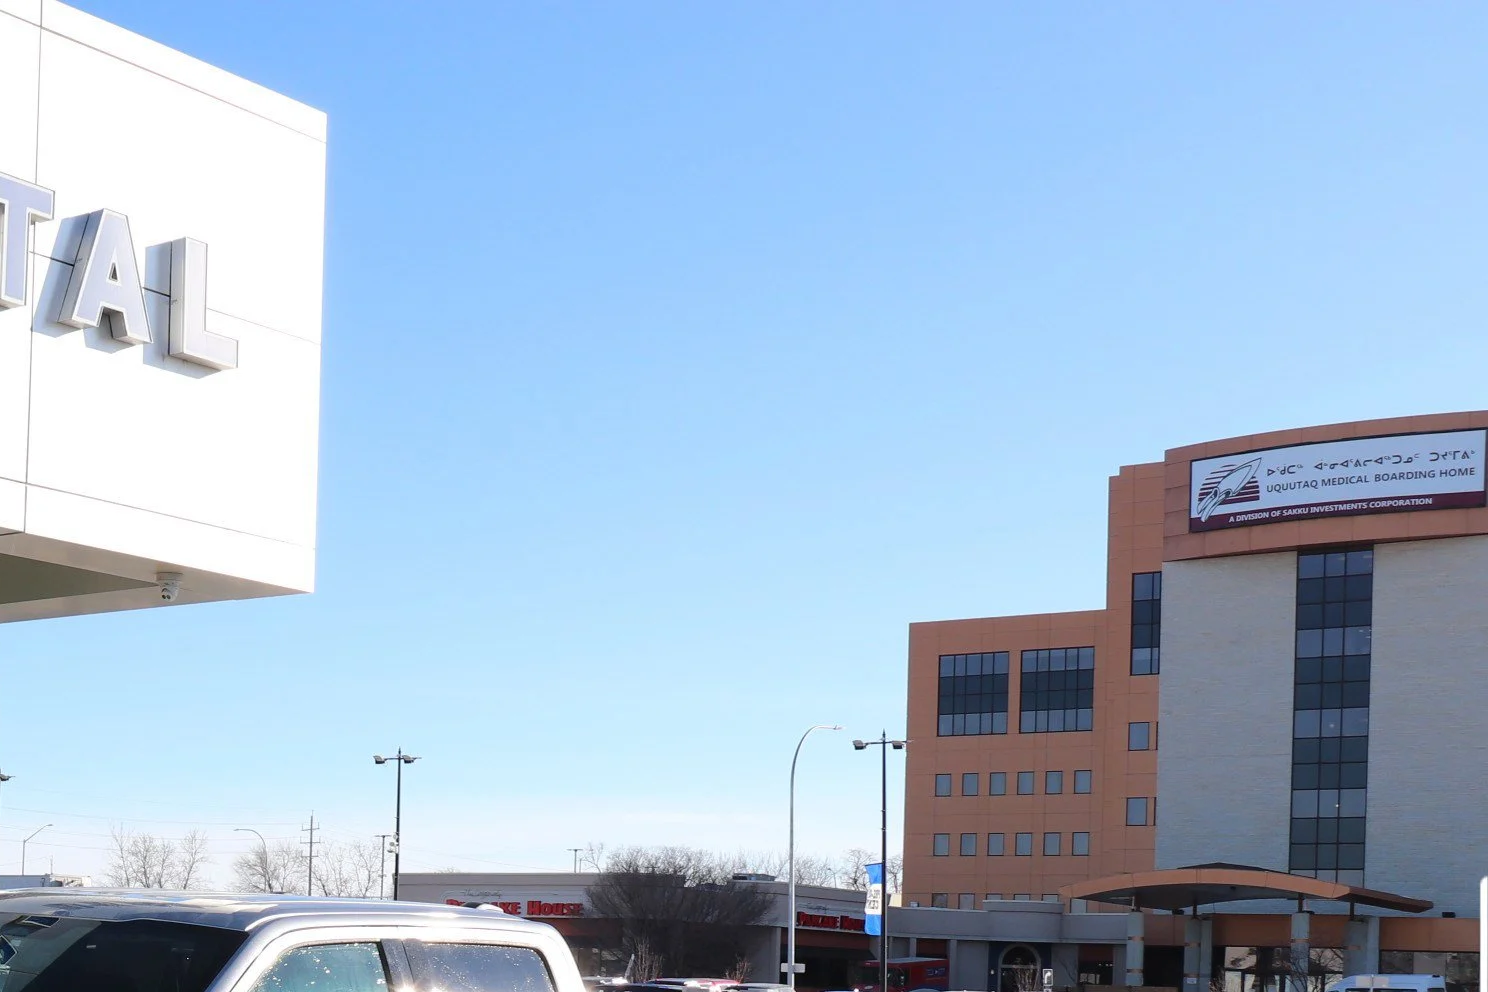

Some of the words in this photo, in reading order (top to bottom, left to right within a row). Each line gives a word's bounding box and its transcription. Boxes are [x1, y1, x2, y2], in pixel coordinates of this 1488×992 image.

[1266, 479, 1318, 493] UQUUTAQ
[1321, 474, 1370, 487] MEDICAL
[1374, 469, 1436, 483] BOARDING
[1439, 467, 1475, 477] HOME
[1235, 511, 1269, 522] DIVISION
[1270, 510, 1281, 518] OF
[1282, 507, 1309, 516] SAKKU
[1310, 503, 1367, 514] INVESTMENTS
[1369, 498, 1433, 509] CORPORATION
